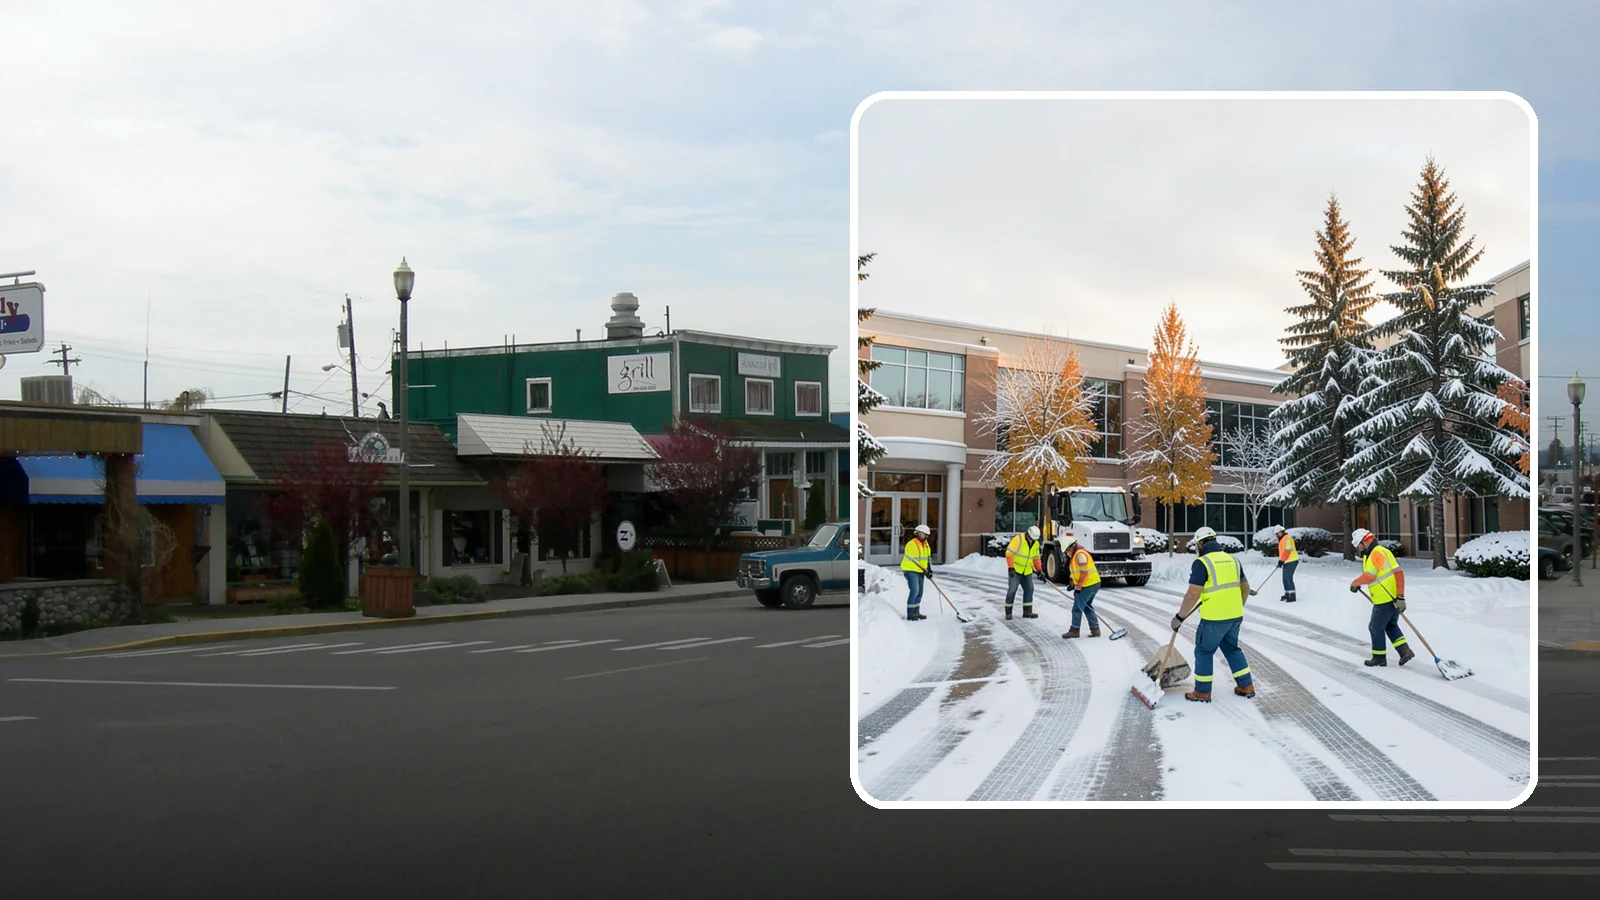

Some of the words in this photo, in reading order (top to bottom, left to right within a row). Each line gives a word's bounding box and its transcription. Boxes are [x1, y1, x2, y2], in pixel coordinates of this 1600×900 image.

[3, 338, 16, 346] Fries
[20, 336, 38, 344] Salads
[617, 355, 655, 392] grill
